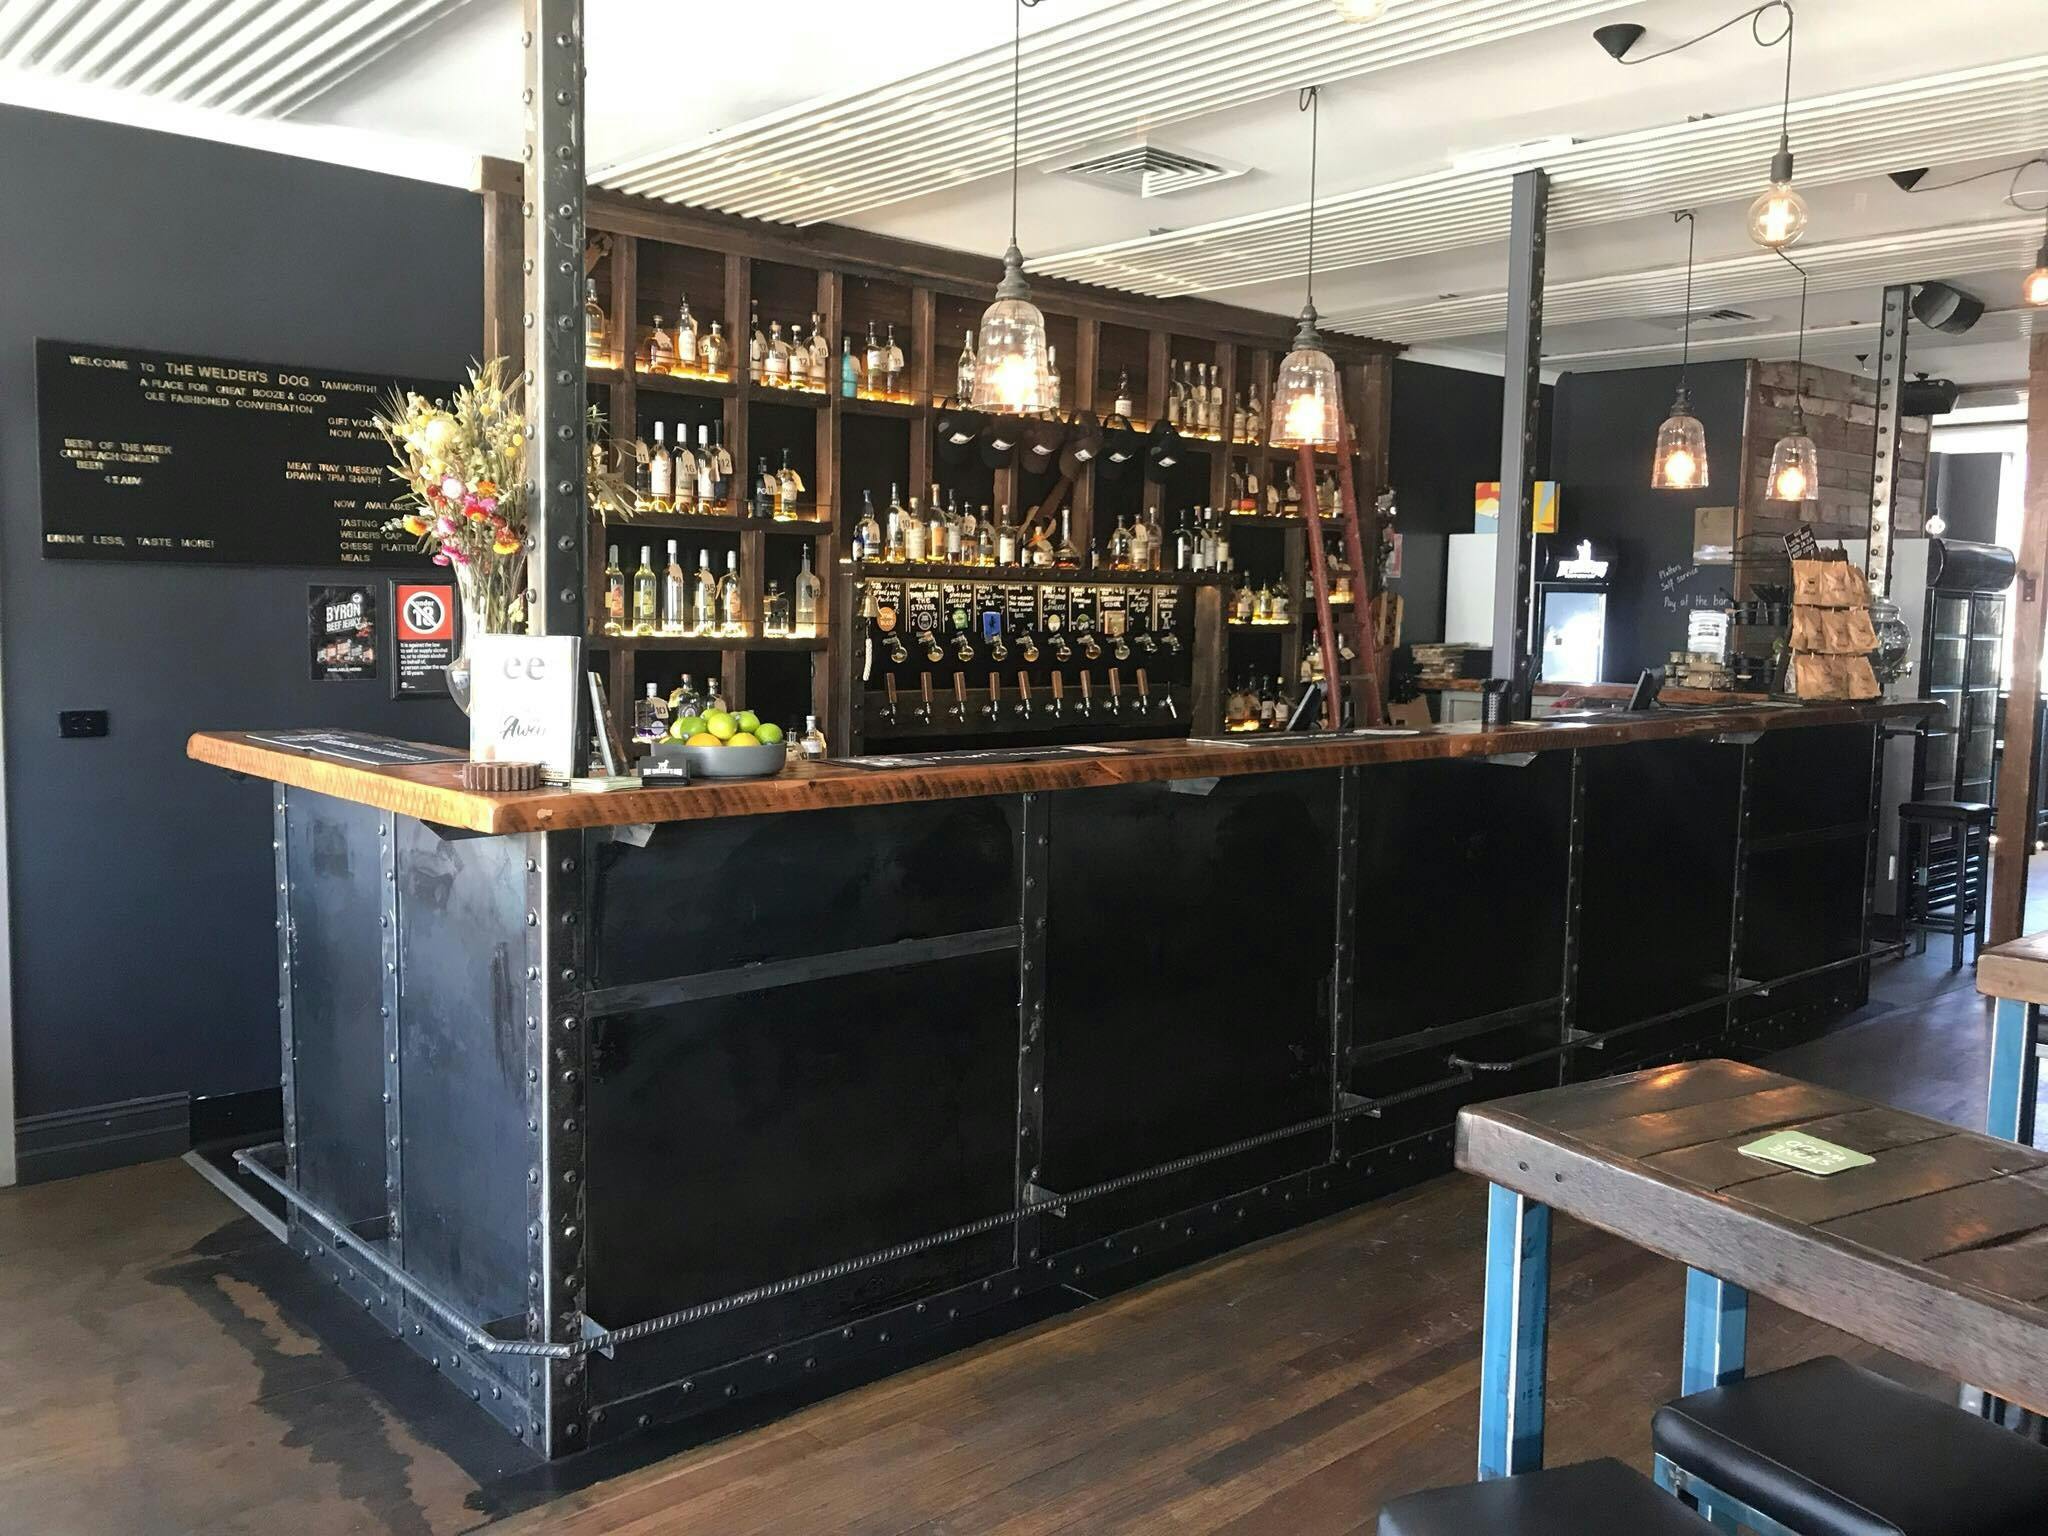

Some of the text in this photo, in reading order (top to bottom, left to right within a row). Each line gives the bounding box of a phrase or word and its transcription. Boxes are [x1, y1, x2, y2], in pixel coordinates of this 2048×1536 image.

[69, 355, 377, 394] WELCOME TO THE WELDER'S DOG TAMWORTH!
[139, 378, 326, 403] A PLACE FOR GREAT BOOZE & GOOD
[171, 394, 229, 407] FASHIONED
[236, 399, 313, 414] CONVERSATION
[328, 417, 349, 426] GIFT
[330, 428, 352, 438] NOW
[64, 438, 172, 454] BEER OF THE WEEK
[85, 450, 119, 461] PEACH
[121, 453, 160, 463] GINGER
[76, 460, 104, 470] BEER
[287, 461, 383, 475] MEAT TRAY TUESDAY
[286, 471, 381, 486] DRAWN 7PM SHARP!
[334, 500, 355, 508] NOW
[340, 519, 378, 528] TASTING
[47, 534, 215, 548] DRINK LESS, TASTE MORE!
[340, 531, 402, 540] WELDERS CAP
[340, 542, 373, 551] CHEESE
[341, 554, 370, 562] MEALS
[910, 603, 937, 611] STAYER
[1664, 593, 1729, 613] Pay at the bar
[326, 602, 361, 623] BYRON
[412, 606, 435, 627] 18
[326, 620, 342, 632] BEEF
